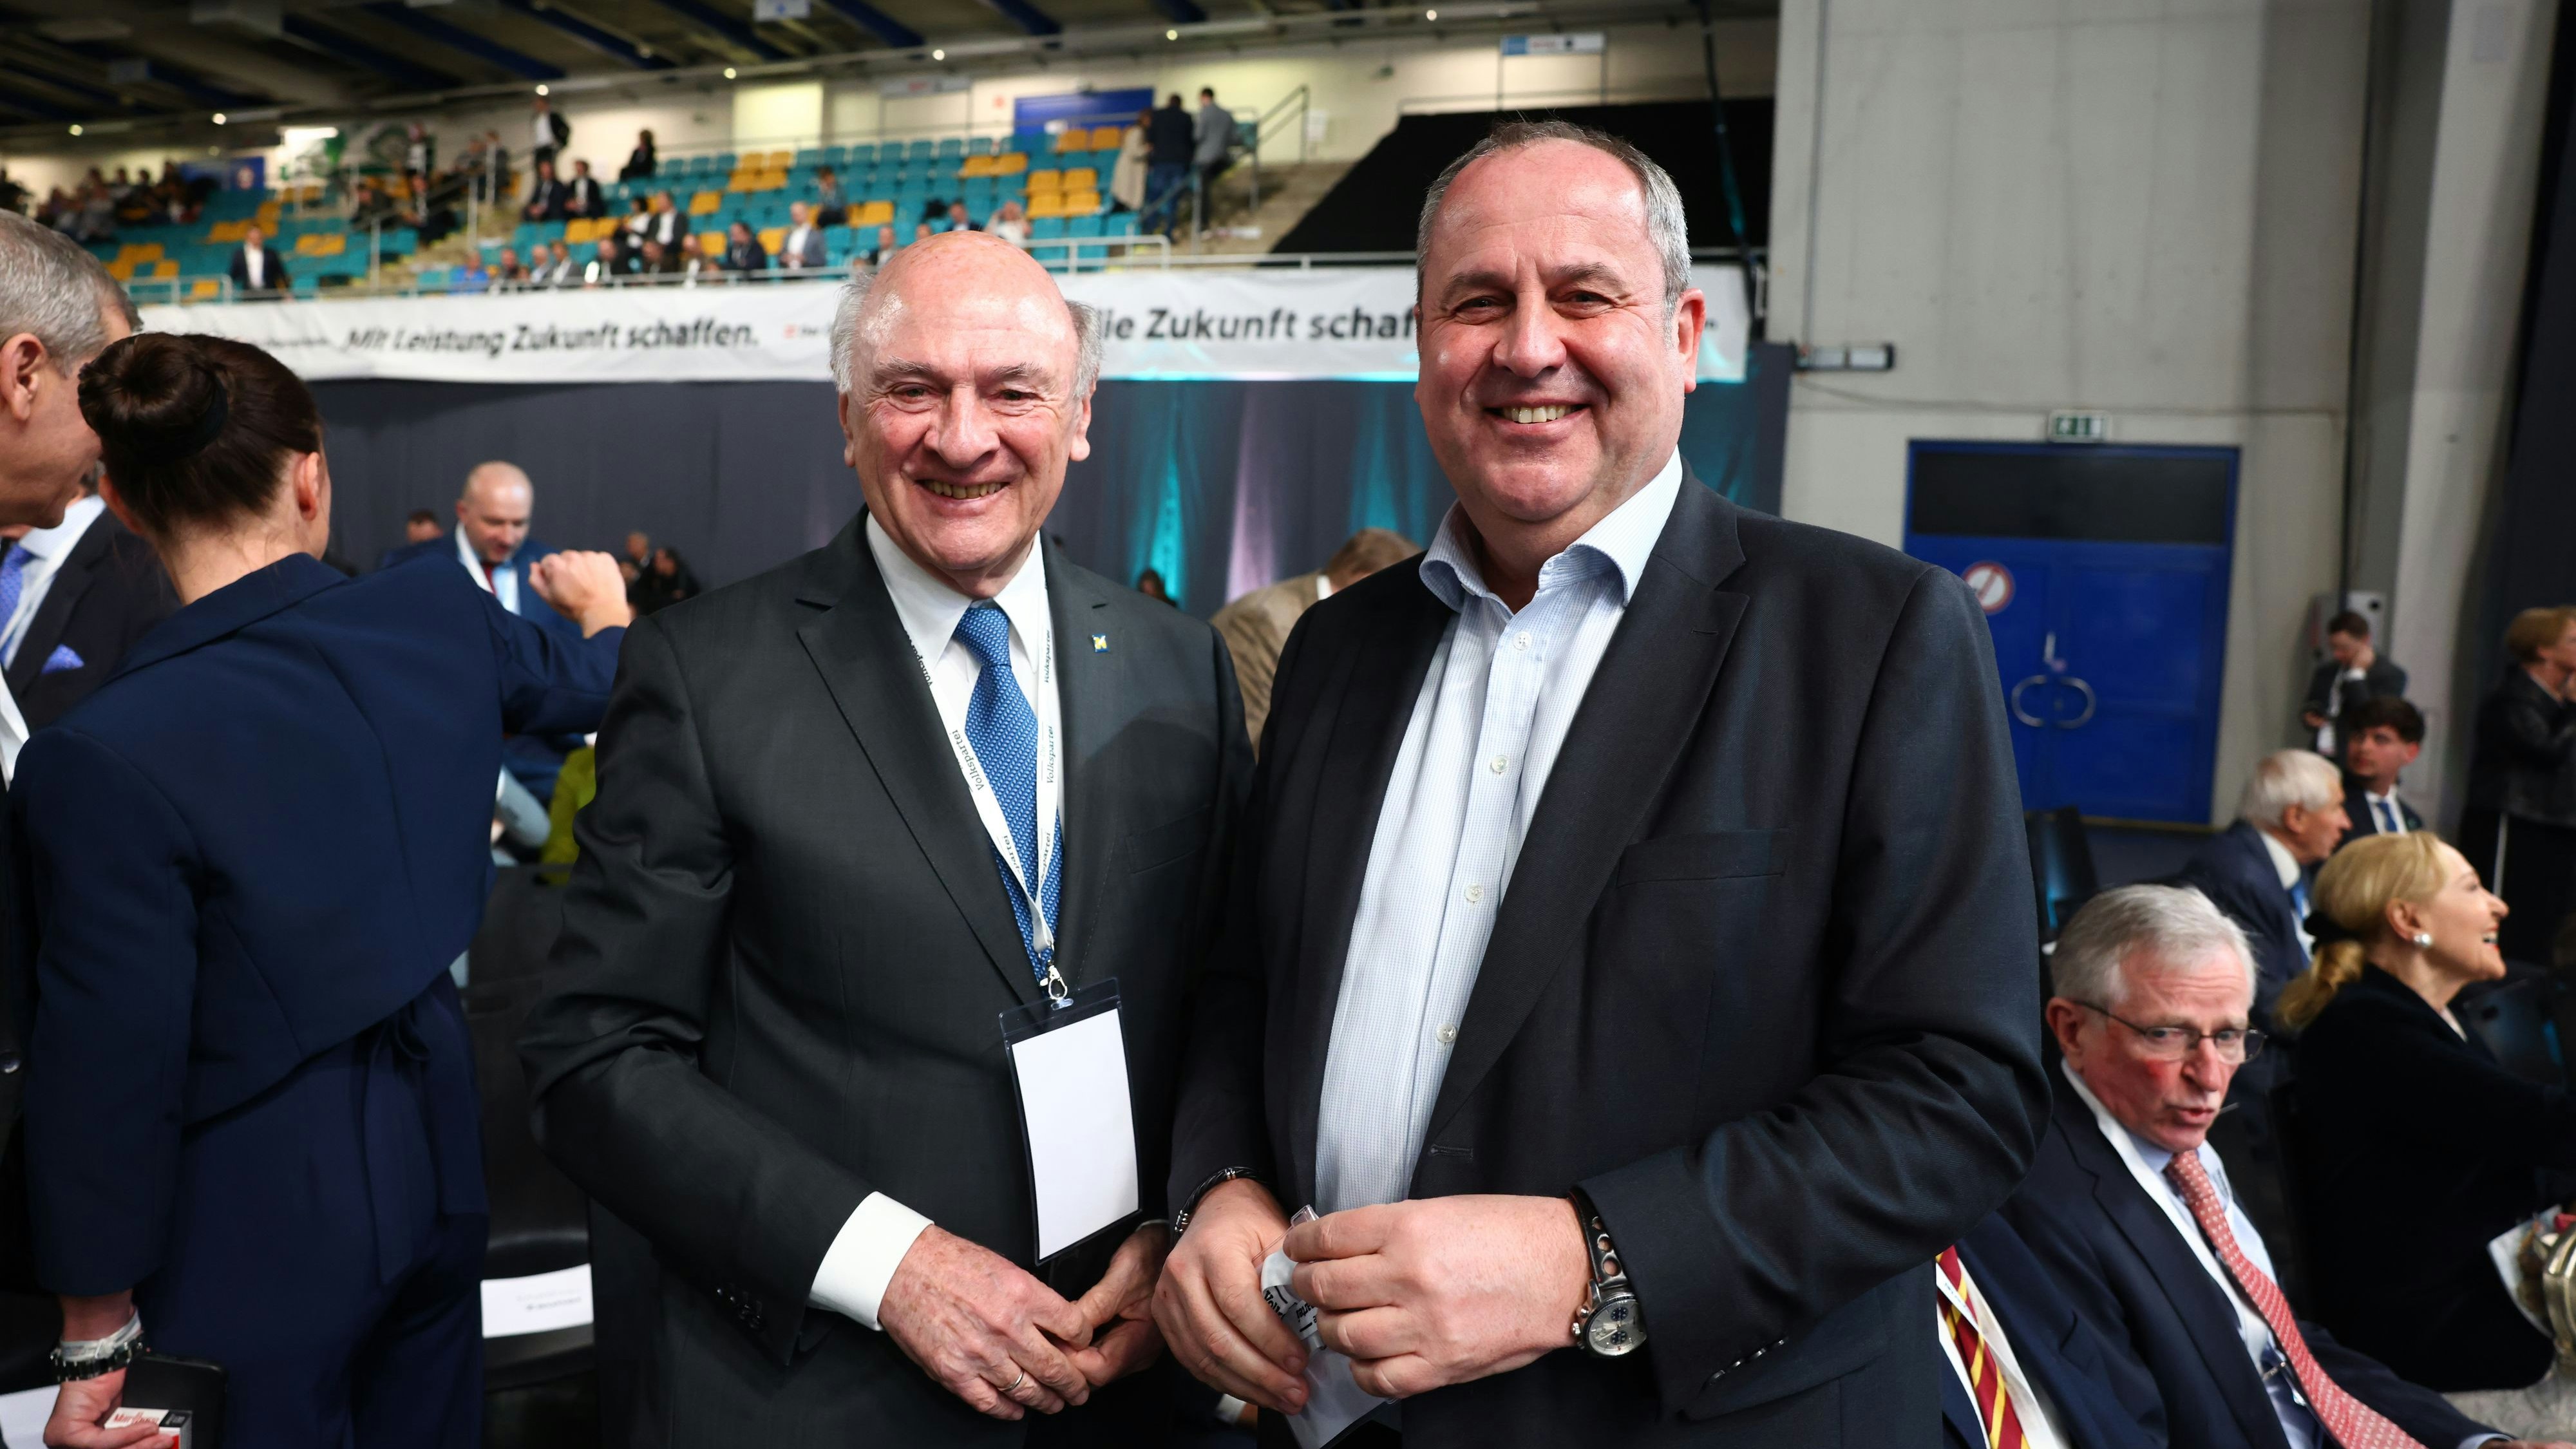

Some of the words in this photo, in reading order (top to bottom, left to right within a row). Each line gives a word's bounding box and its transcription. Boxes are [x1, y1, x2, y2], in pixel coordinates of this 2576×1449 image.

[393, 325, 504, 359] Leistung
[513, 322, 618, 351] Zukunft
[1097, 308, 1134, 339] ie
[1147, 307, 1295, 339] Zukunft
[1309, 304, 1415, 339] schaf
[949, 729, 985, 791] Volkspartei
[1046, 725, 1056, 784] Volkspartei
